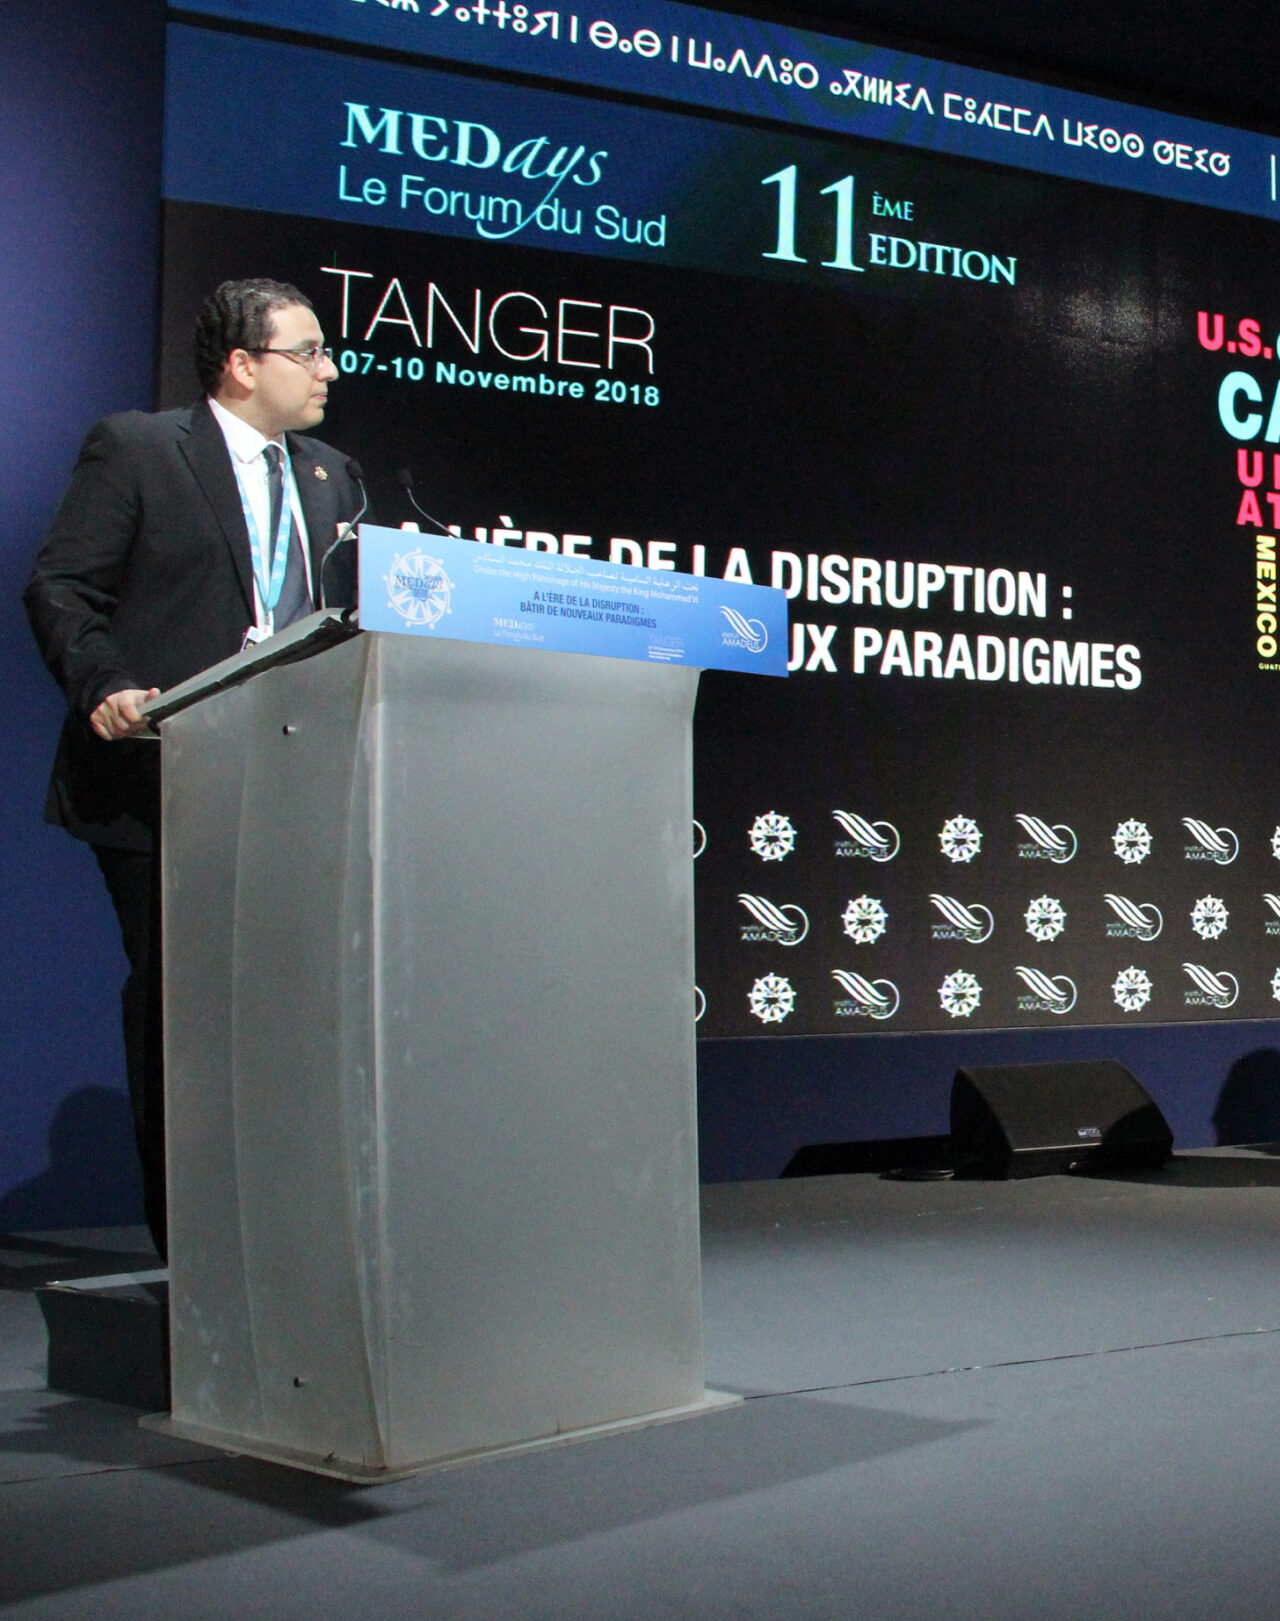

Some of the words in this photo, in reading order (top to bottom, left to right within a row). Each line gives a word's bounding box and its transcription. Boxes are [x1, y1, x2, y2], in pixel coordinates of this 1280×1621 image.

[338, 101, 608, 205] MEDays
[338, 164, 387, 206] Le
[400, 176, 522, 226] Forum
[536, 200, 582, 234] du
[595, 208, 666, 246] Sud
[761, 164, 865, 273] 11
[872, 191, 914, 222] ÈME
[868, 233, 1018, 286] EDITION
[319, 266, 654, 374] TANGER
[1196, 310, 1273, 360] U.S.
[340, 349, 424, 381] 07-10
[435, 361, 585, 399] Novembre
[594, 378, 660, 407] 2018
[520, 600, 544, 614] BÂTIR
[547, 604, 558, 616] DE
[560, 606, 603, 622] NOUVEAUX
[606, 613, 656, 628] PARADIGMES
[534, 591, 540, 600] A
[566, 596, 577, 606] DE
[580, 597, 591, 607] LA
[592, 598, 640, 614] DISRUPTION
[772, 551, 1047, 618] DISRUPTION
[1256, 534, 1278, 658] MEXICO
[853, 626, 1142, 691] PARADIGMES
